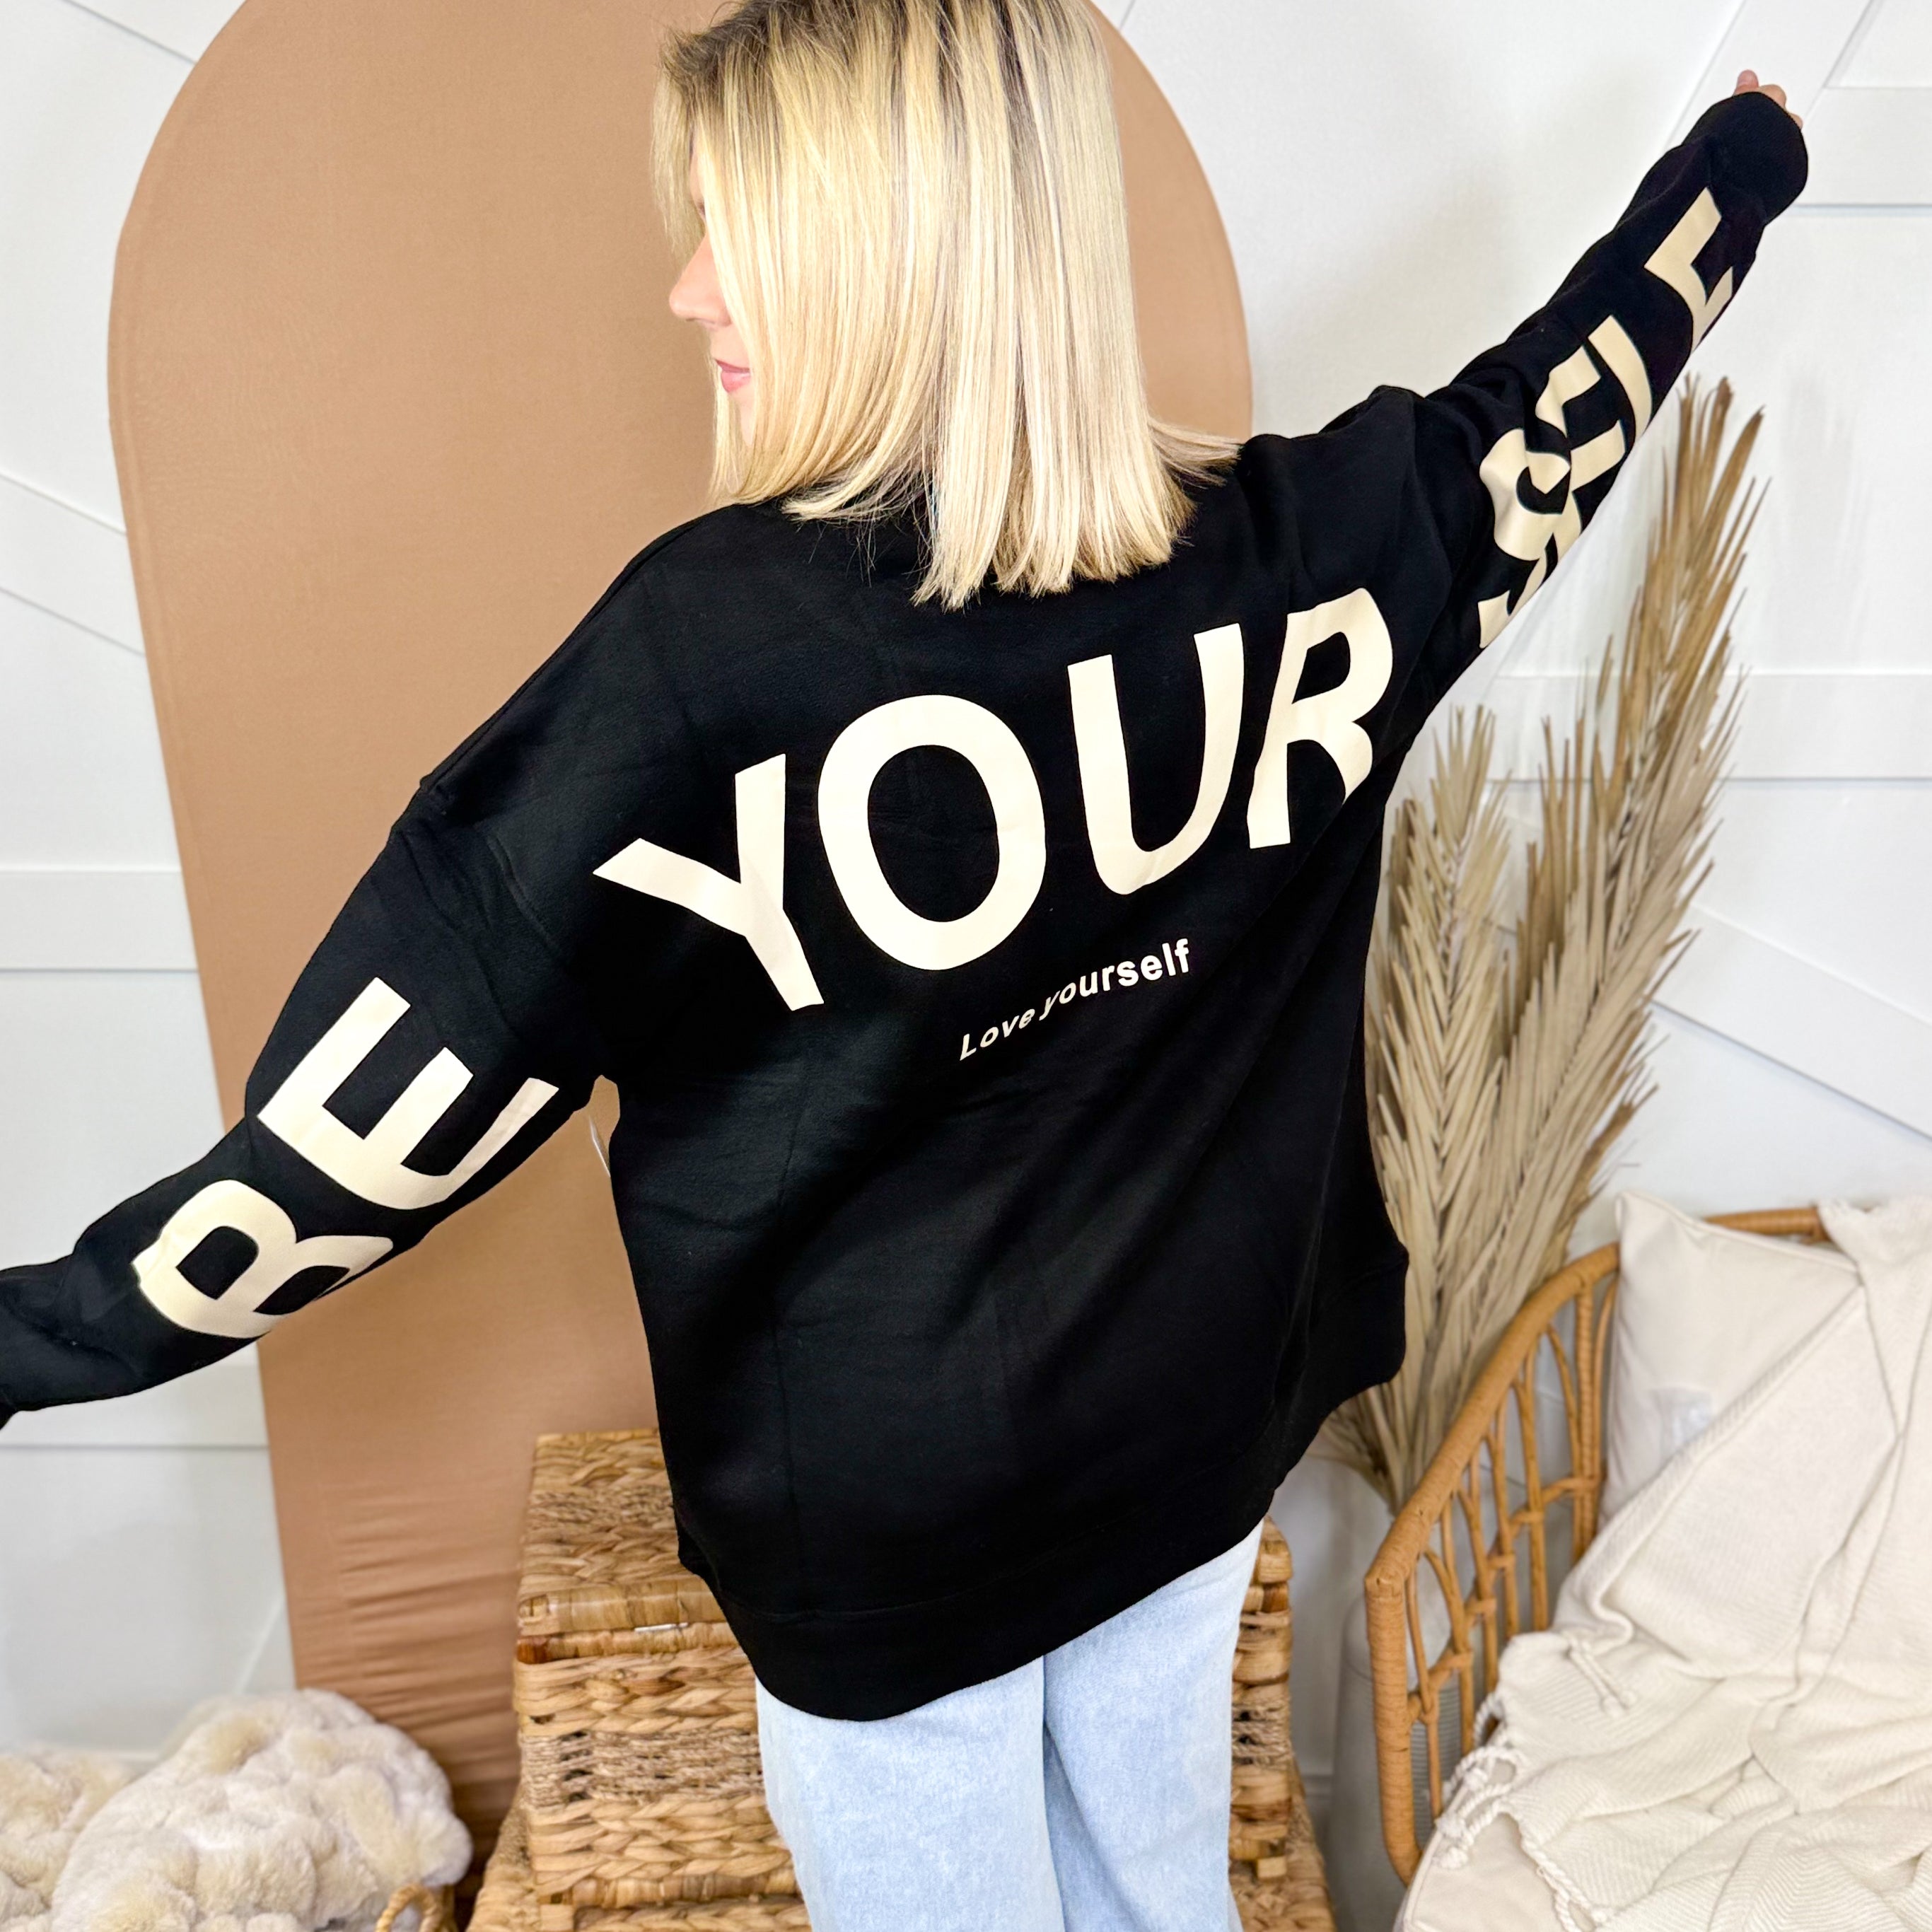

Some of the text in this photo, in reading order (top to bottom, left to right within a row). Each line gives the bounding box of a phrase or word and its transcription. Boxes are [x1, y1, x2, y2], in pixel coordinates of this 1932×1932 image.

[131, 977, 559, 1339] BE
[592, 587, 1393, 1011] YOUR
[959, 938, 1189, 1061] Love yourself
